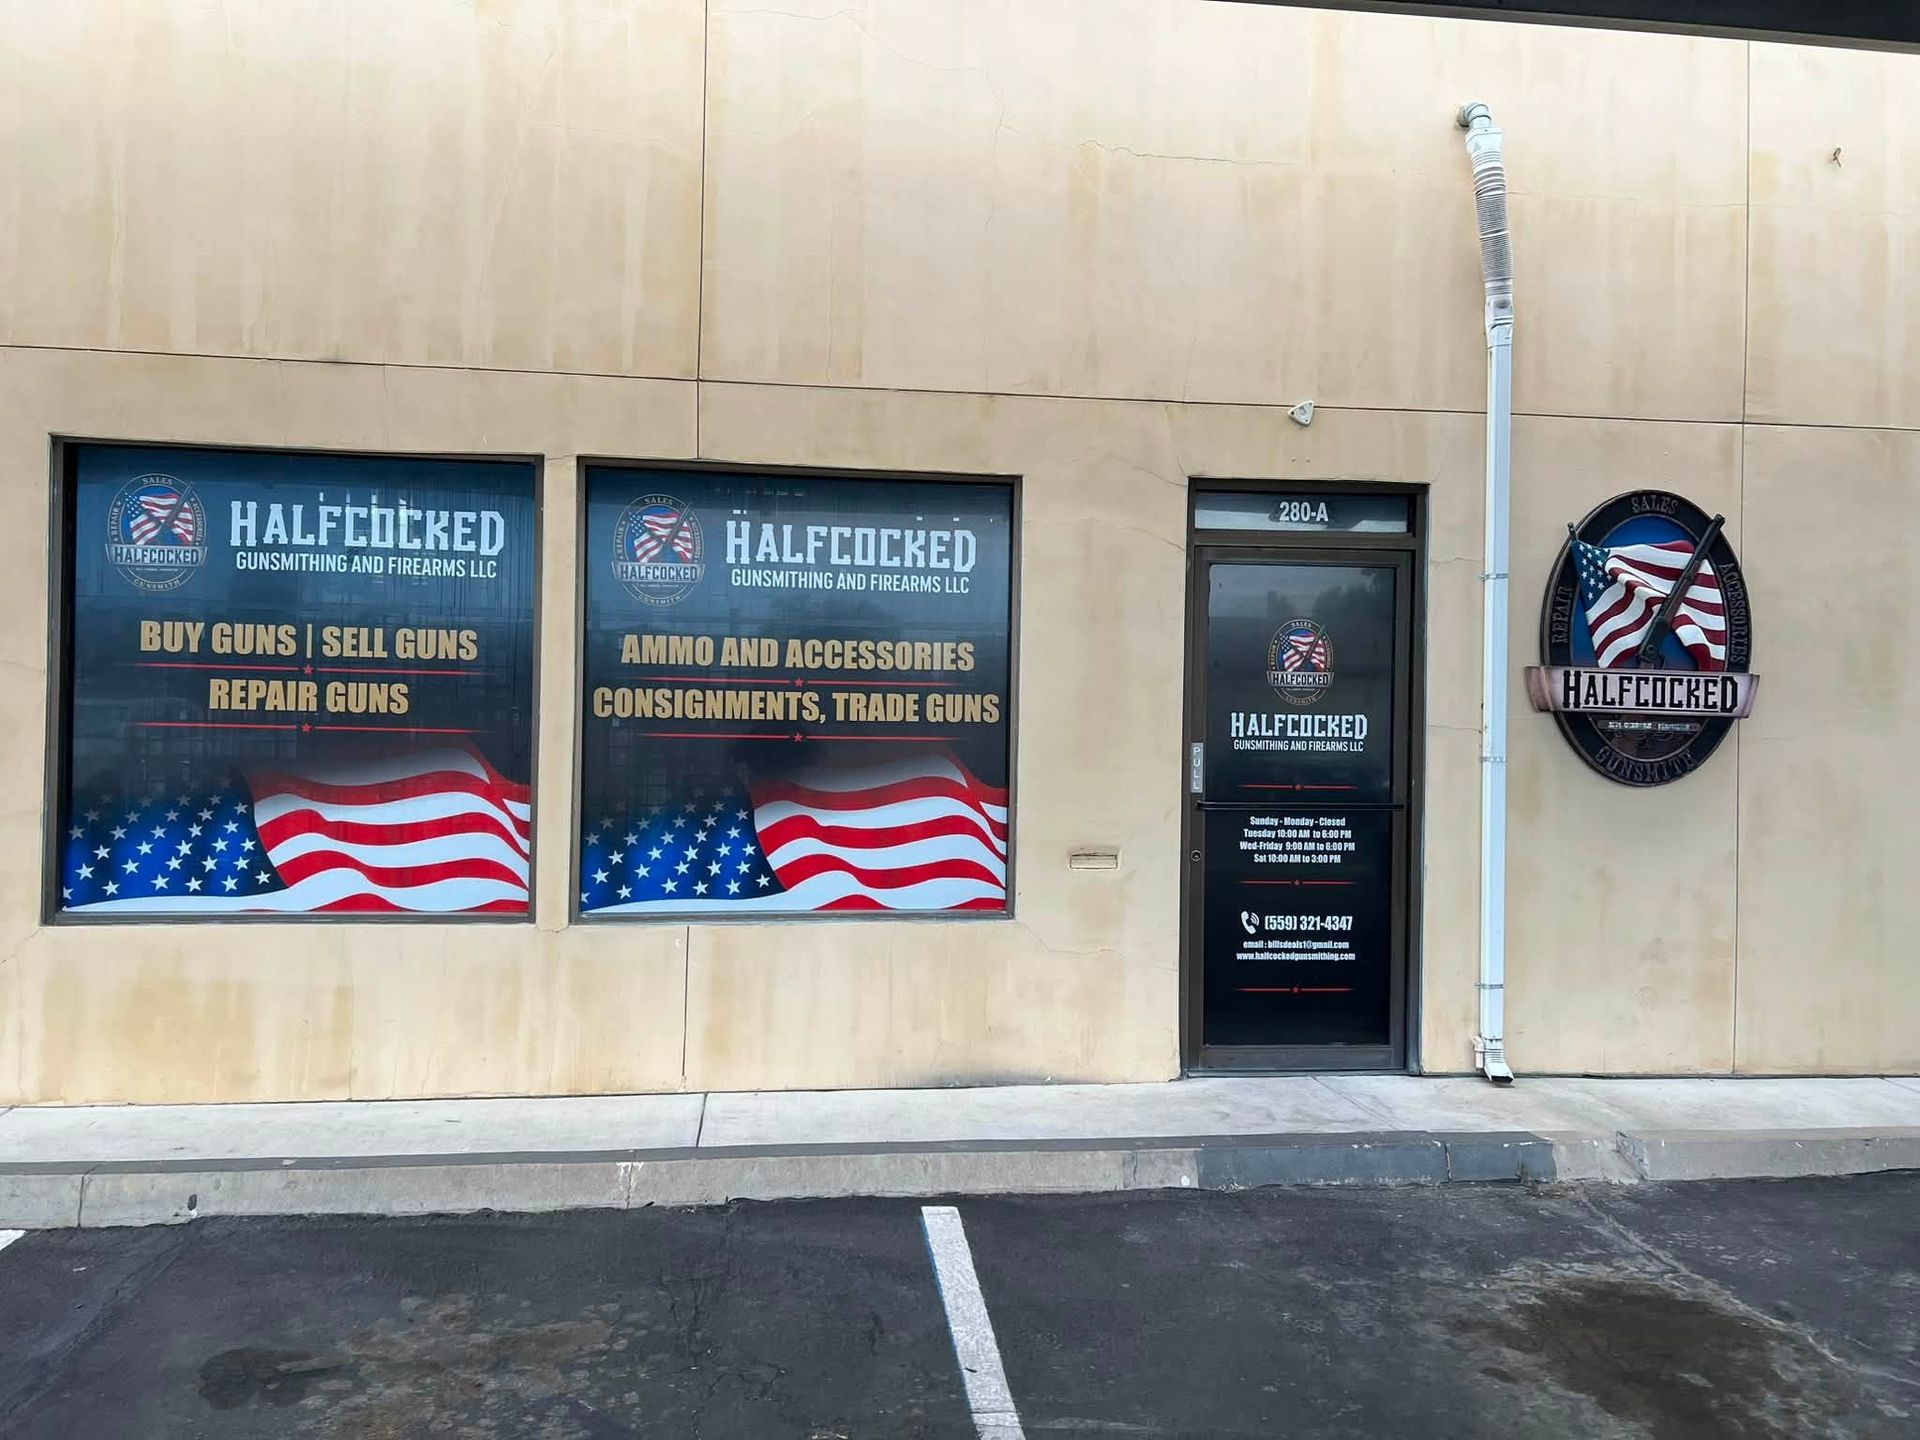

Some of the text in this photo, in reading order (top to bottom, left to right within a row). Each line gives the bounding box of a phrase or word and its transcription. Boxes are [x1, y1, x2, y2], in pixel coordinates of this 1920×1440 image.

[142, 477, 173, 485] SALES
[644, 497, 673, 505] SALES
[1631, 495, 1678, 514] SALES
[1279, 502, 1329, 522] 280-A
[230, 500, 505, 556] HALFCOCKED
[114, 546, 199, 564] HALFCOCKED
[726, 520, 977, 573] HALFCOCKED
[236, 551, 497, 579] GUNSMITHING AND FIREARMS LLC
[620, 564, 698, 581] HALFCOCKED
[731, 569, 970, 594] GUNSMITHING AND FIREARMS LLC
[1551, 585, 1573, 645] REPAIR
[1720, 562, 1748, 666] ACCESSORIES
[140, 620, 205, 653] BUY
[211, 623, 297, 656] GUNS
[322, 625, 388, 659] SELL
[394, 628, 478, 661] GUNS
[620, 634, 975, 672] AMMO AND ACCESSORIES
[1272, 673, 1329, 686] HALFCOCKED
[209, 678, 410, 714] REPAIR GUNS
[1562, 669, 1738, 714] HALFCOCKED
[593, 687, 1000, 725] CONSIGNMENTS, TRADE GUNS
[1231, 712, 1368, 739] HALFCOCKED
[1233, 739, 1364, 752] GUNSMITHING AND FIREARMS LLC
[1193, 746, 1201, 790] PULL
[1596, 746, 1697, 782] GUNSMITH
[1250, 816, 1279, 827] Sunday
[1284, 817, 1314, 827] Monday
[1319, 817, 1346, 826] Closed
[1243, 828, 1352, 839] Tuesday 10:00 AM to 6:00 PM
[1240, 841, 1355, 851] Wed-Friday 9:00 AM to 6:00 PM
[1253, 853, 1341, 863] Sat 10:00 AM to 3:00 PM
[1264, 915, 1353, 931] (559) 321-4347
[1243, 940, 1264, 949] email
[1236, 952, 1356, 961] www.halfcockedgunsmithing.com
